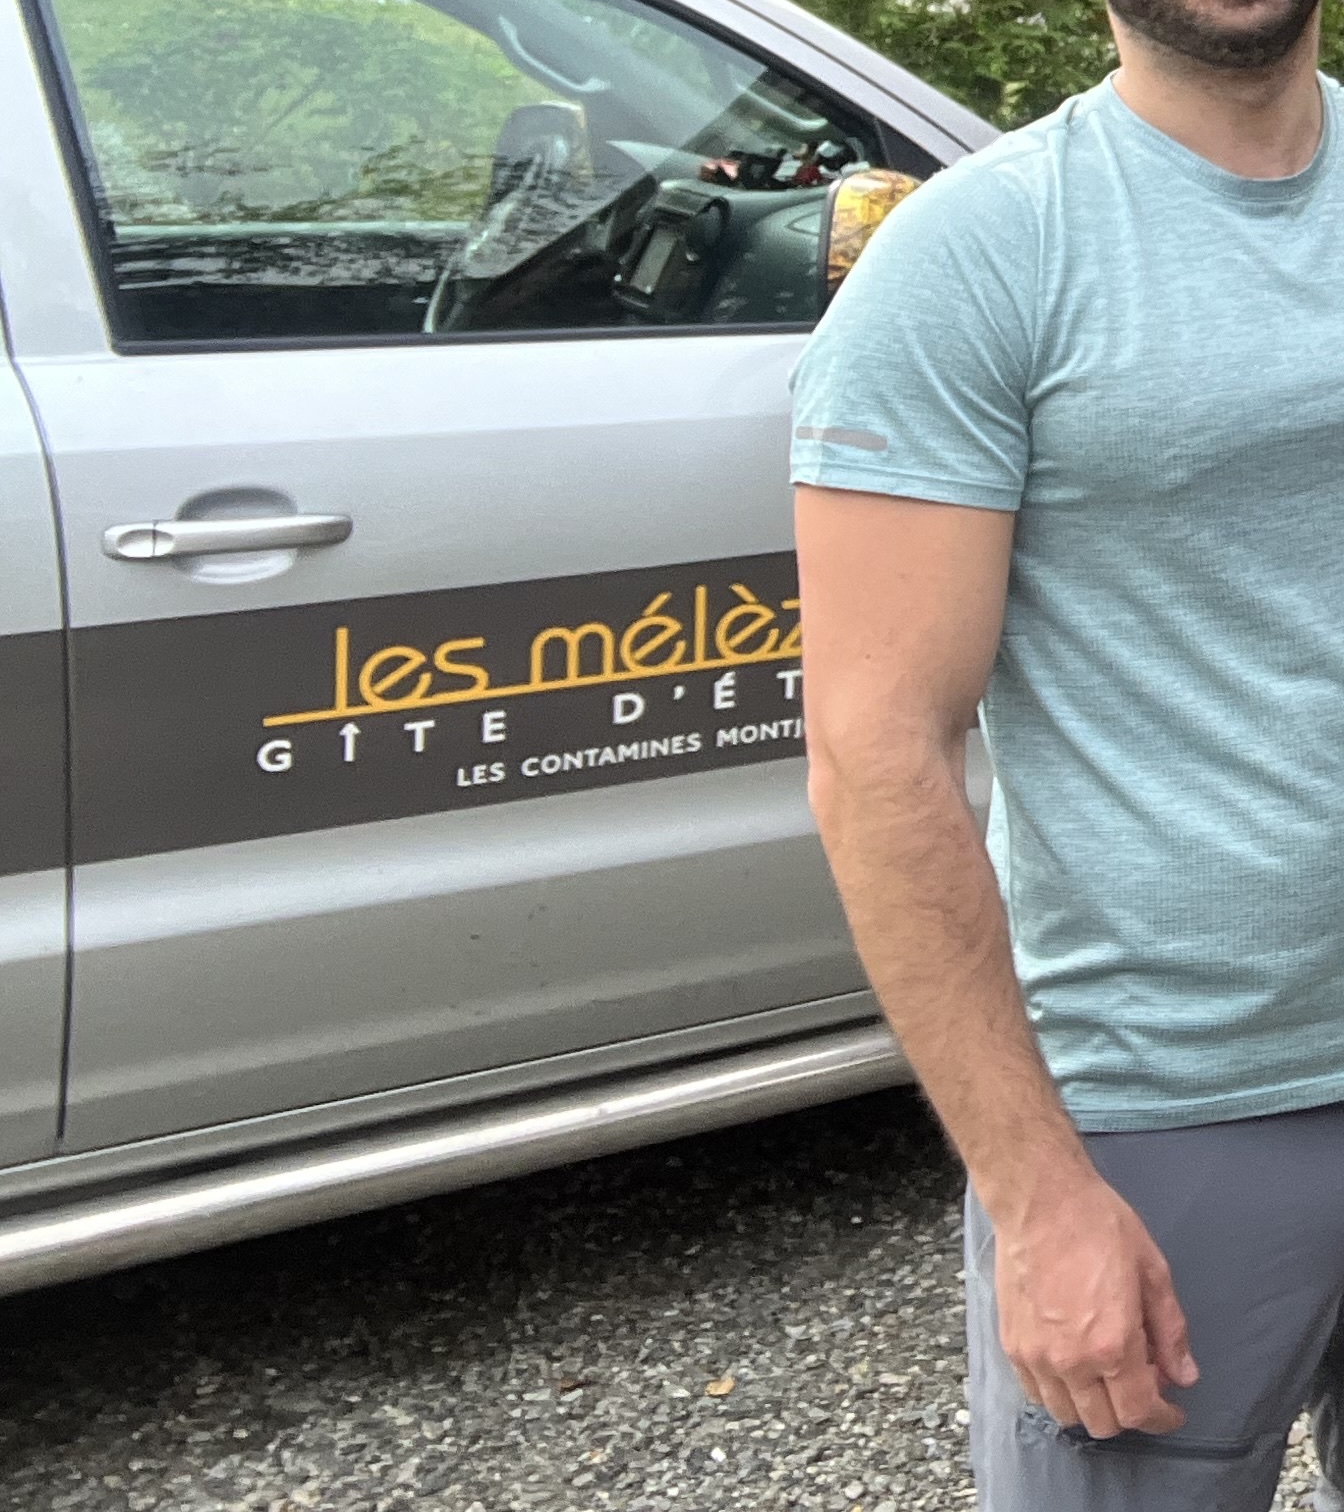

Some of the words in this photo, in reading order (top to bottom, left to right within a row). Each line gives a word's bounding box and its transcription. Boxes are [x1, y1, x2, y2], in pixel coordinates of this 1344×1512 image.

[336, 625, 490, 710] les
[531, 582, 802, 685] mélèz
[457, 763, 506, 787] LES
[521, 731, 702, 779] CONTAMINES
